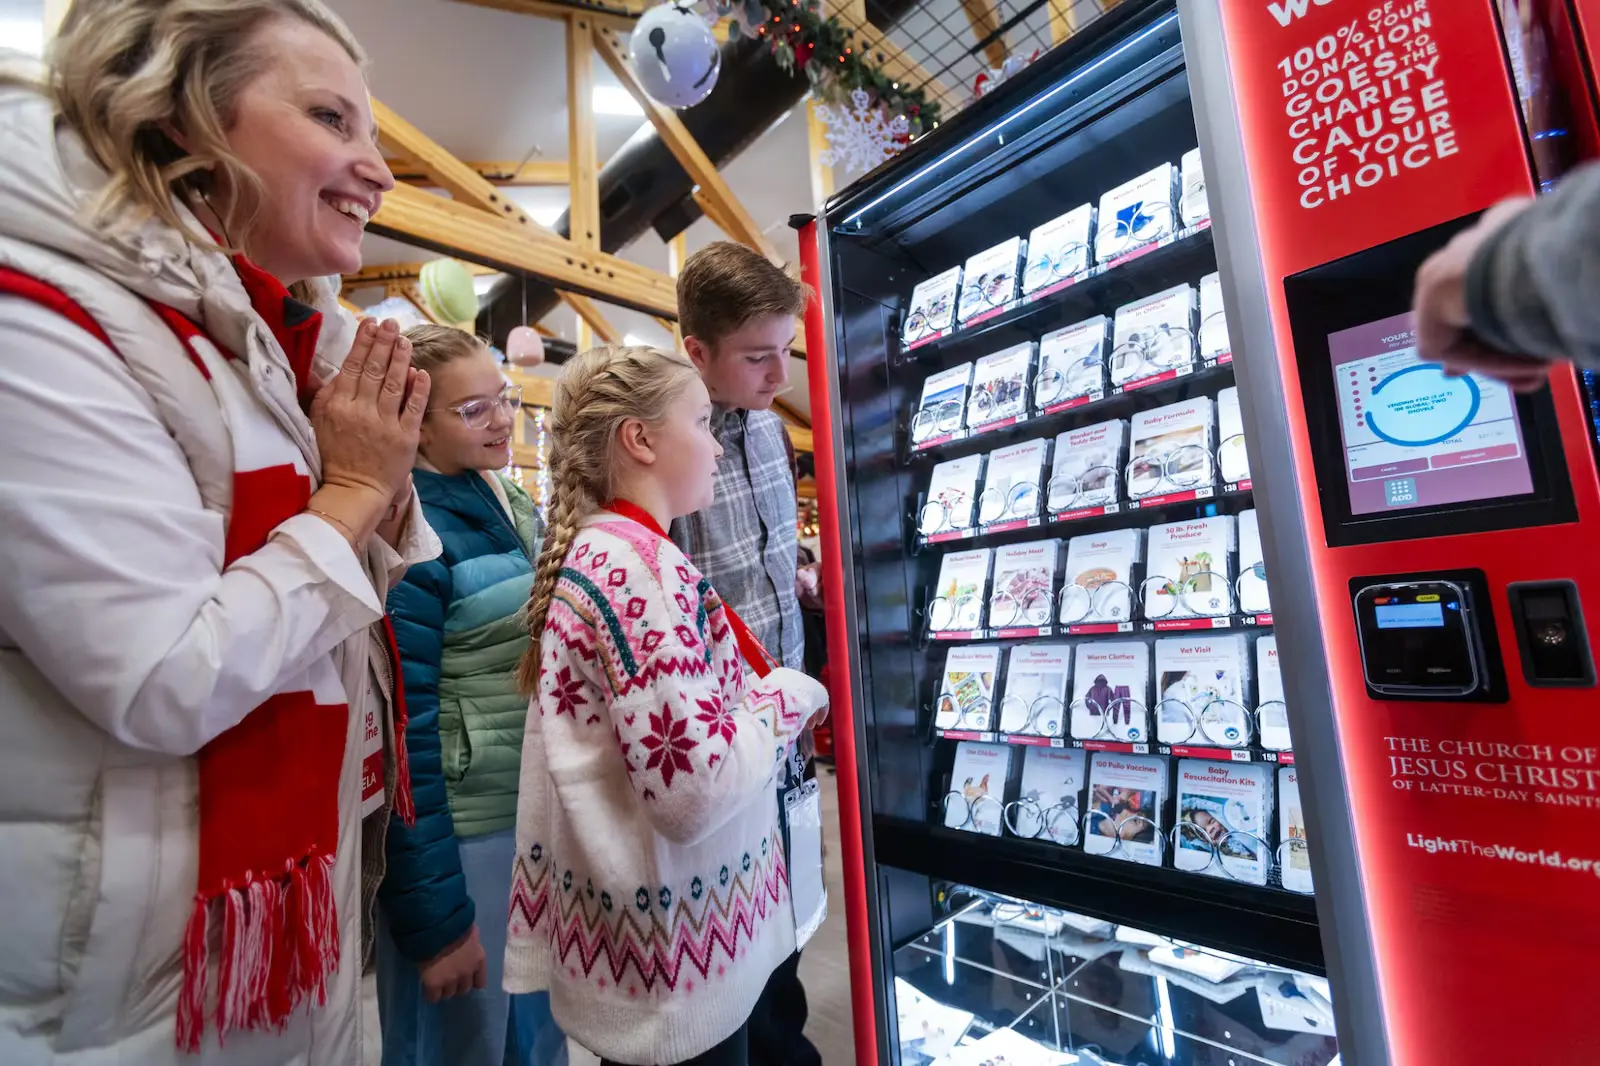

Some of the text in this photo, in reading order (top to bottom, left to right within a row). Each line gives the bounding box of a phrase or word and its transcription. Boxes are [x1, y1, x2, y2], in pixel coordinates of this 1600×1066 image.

[1369, 0, 1427, 33] YOUR
[1277, 1, 1393, 78] 100% OF
[1282, 15, 1432, 97] DONATION
[1400, 41, 1438, 66] THE
[1286, 34, 1430, 117] GOES TO
[1288, 55, 1440, 139] CHARITY
[1292, 80, 1448, 164] CAUSE
[1298, 111, 1452, 186] OF YOUR
[1300, 130, 1459, 209] CHOICE
[1381, 332, 1408, 344] YOUR
[1387, 399, 1414, 409] VENDING
[1144, 409, 1195, 425] Baby Formula
[1223, 484, 1237, 492] 138
[1391, 494, 1412, 502] ADD
[1186, 522, 1207, 531] Fresh
[1170, 531, 1202, 540] Produce
[1241, 617, 1255, 625] 148
[1194, 646, 1211, 654] Visit
[1262, 753, 1277, 761] 158
[1384, 736, 1597, 764] THE CHURCH OF
[1126, 764, 1157, 773] Vaccines
[1208, 767, 1229, 777] Baby
[1388, 756, 1600, 791] JESUS CHRIST
[1183, 773, 1256, 787] Resuscitation Kits
[1392, 780, 1414, 790] OF
[1419, 781, 1528, 801] LATTER-DAY
